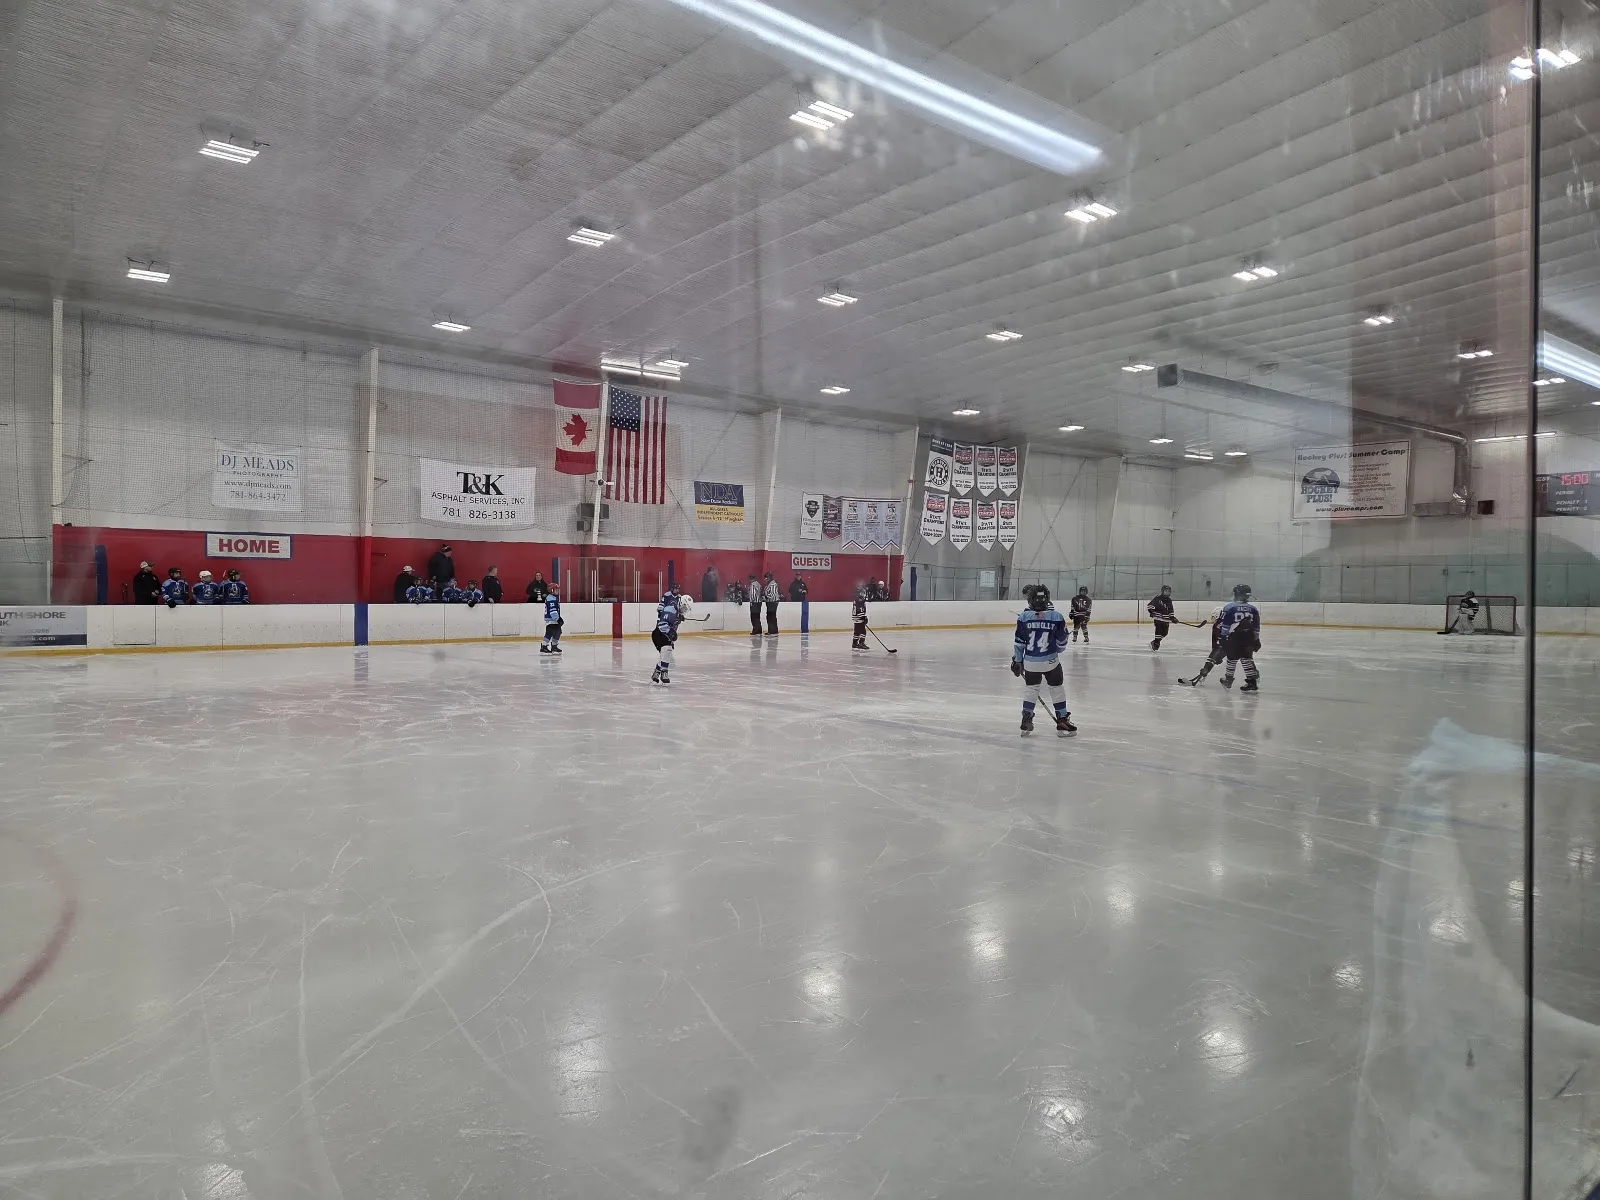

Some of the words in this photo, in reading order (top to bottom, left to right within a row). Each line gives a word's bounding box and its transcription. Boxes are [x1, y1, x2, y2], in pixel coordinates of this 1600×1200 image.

[221, 454, 238, 469] DJ
[243, 456, 295, 472] MEADS
[224, 480, 292, 490] www.djmeads.com
[456, 471, 505, 495] T&K
[230, 490, 286, 502] 781-864-3472
[700, 482, 738, 500] NDA
[1300, 486, 1340, 494] HOCKEY
[431, 491, 467, 503] ASPHALT
[469, 497, 509, 506] SERVICES,
[1306, 494, 1333, 503] PLUS!
[442, 507, 461, 517] 781
[468, 510, 516, 519] 826-3138
[218, 537, 280, 554] HOME
[793, 557, 830, 567] GUESTS
[1027, 631, 1049, 652] 14
